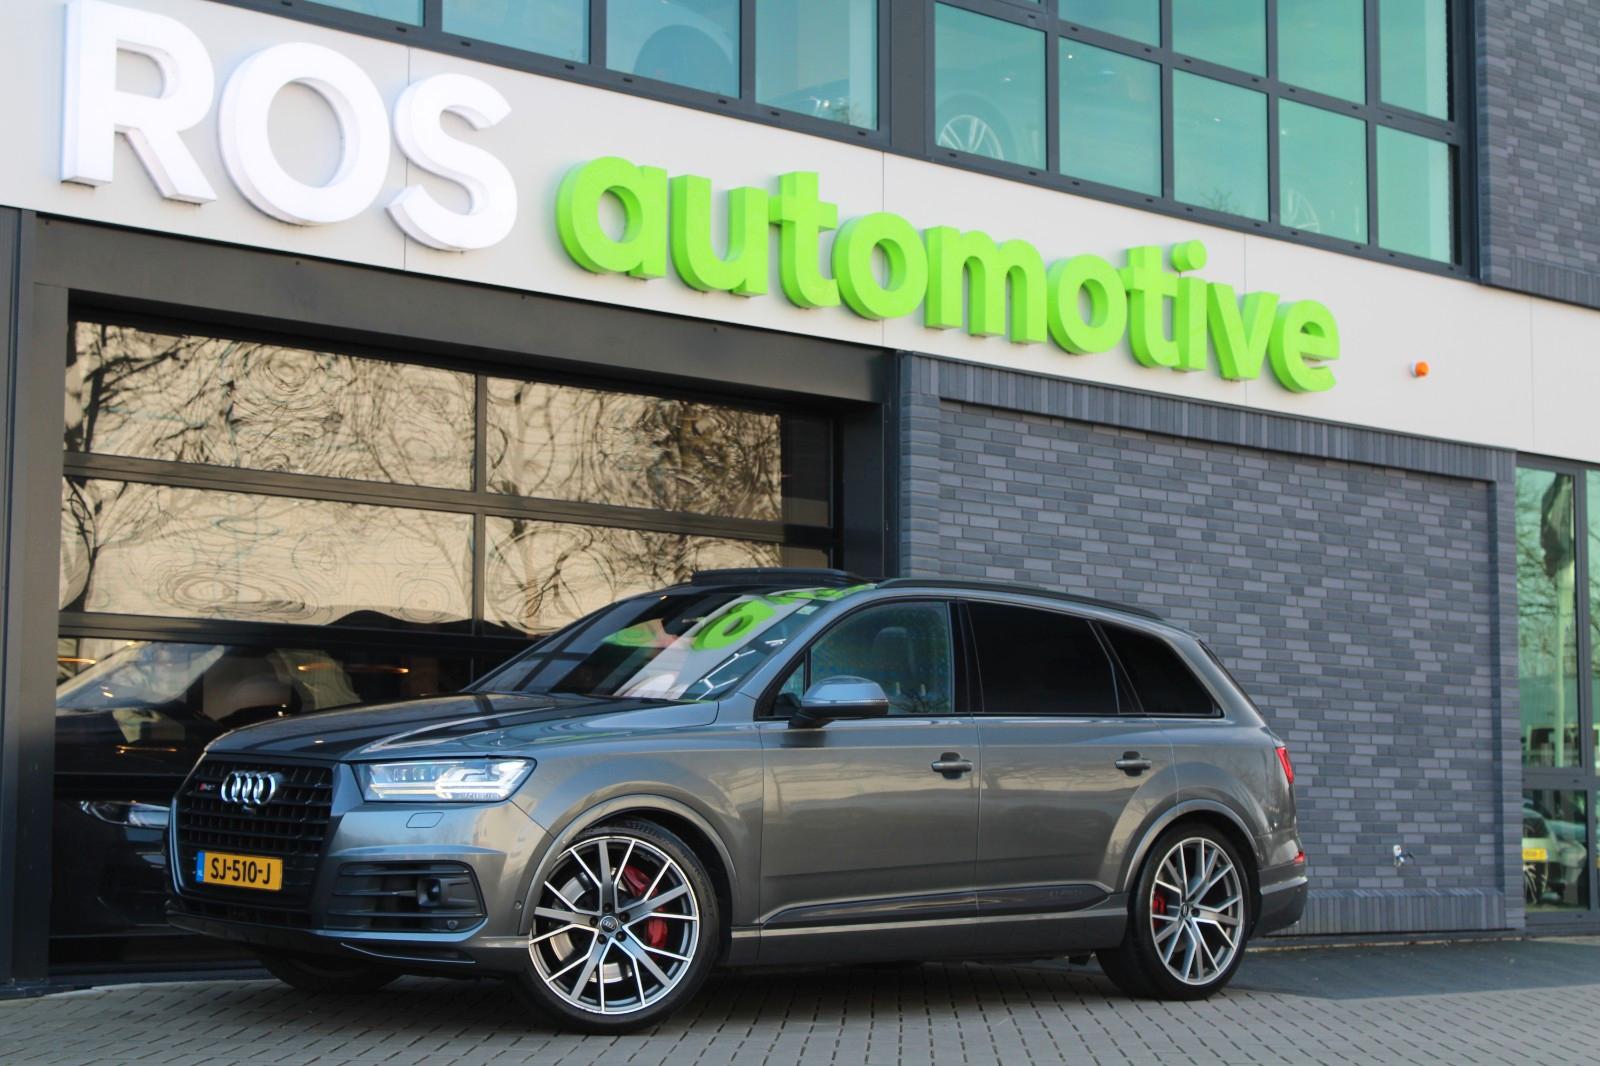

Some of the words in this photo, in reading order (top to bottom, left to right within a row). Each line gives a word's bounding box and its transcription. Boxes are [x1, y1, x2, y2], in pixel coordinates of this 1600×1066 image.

[61, 0, 519, 252] ROS
[556, 156, 1340, 394] automotive
[211, 857, 271, 885] SJ-510-J
